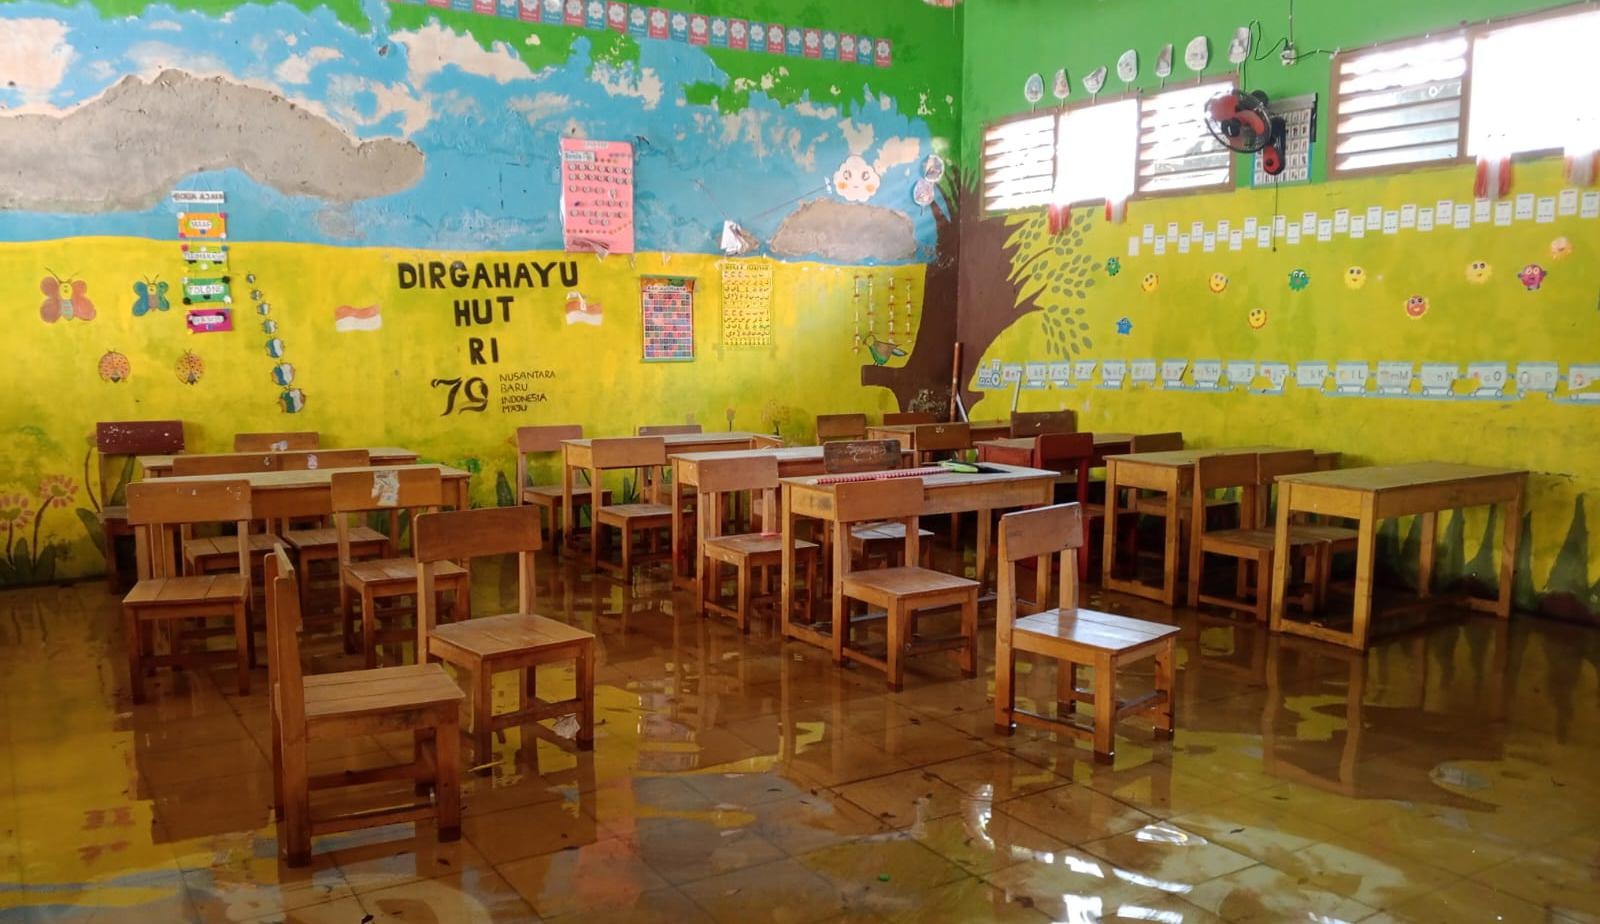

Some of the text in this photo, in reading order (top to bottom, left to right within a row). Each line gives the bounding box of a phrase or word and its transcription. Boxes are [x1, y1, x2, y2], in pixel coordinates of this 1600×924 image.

[397, 261, 579, 290] DIRGAHAYU
[453, 296, 515, 327] HUT
[468, 337, 499, 365] RI
[499, 370, 556, 382] NUSANTARA
[500, 384, 529, 394] BARU
[430, 376, 489, 416] 79
[501, 393, 548, 405] INDONESIA
